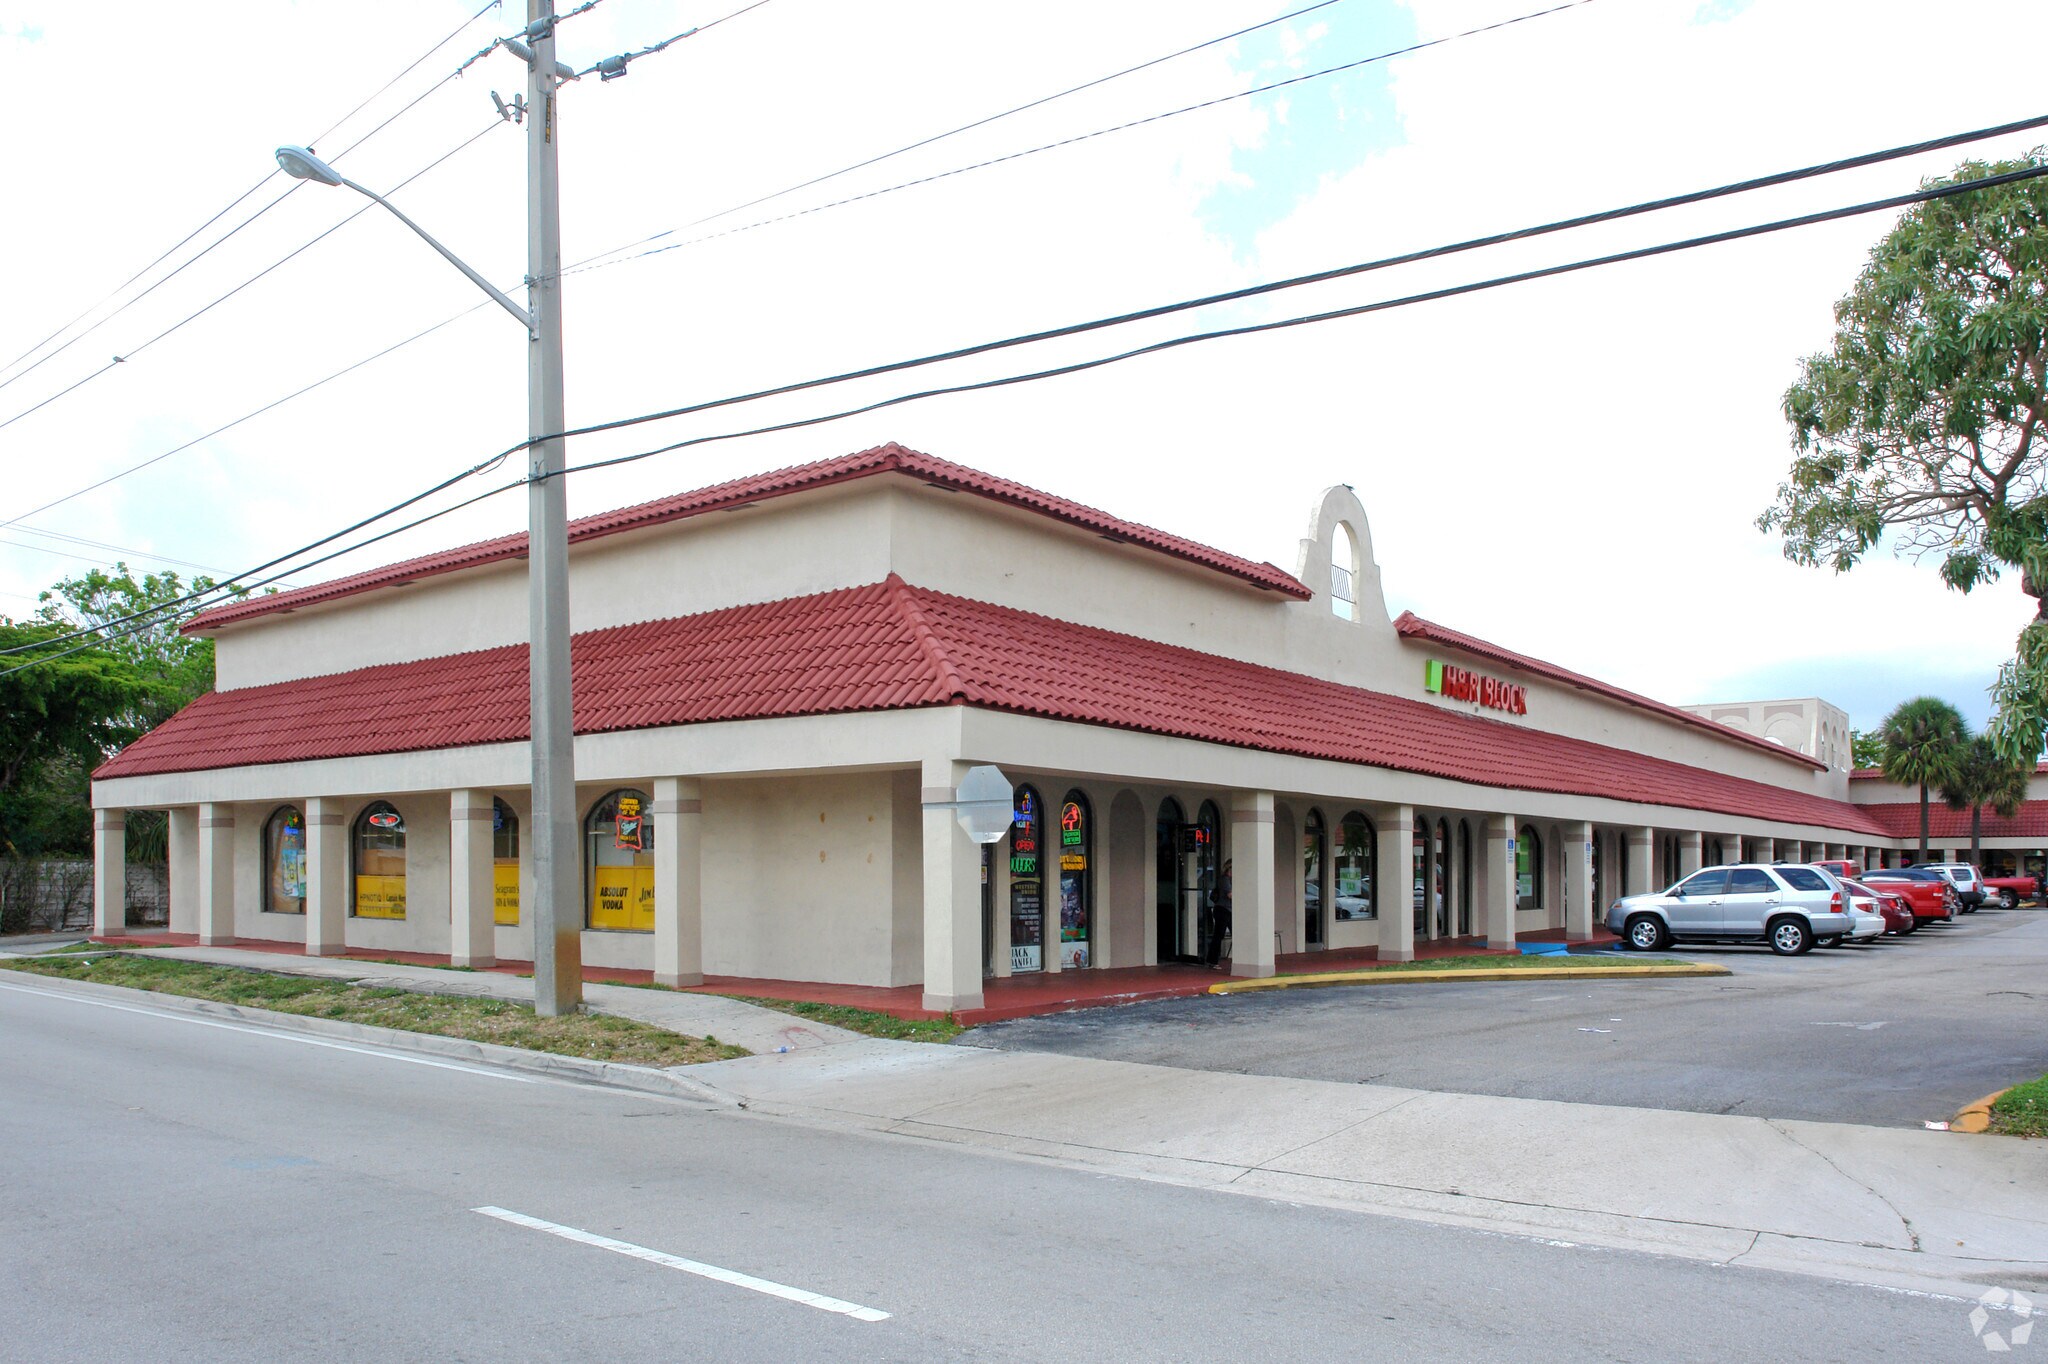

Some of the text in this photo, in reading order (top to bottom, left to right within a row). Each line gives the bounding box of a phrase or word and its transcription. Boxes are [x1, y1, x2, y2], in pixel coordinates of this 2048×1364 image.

[1442, 665, 1528, 715] H&R BLOCK
[1015, 840, 1035, 851] OPEN
[600, 887, 628, 897] ABSOLUT
[602, 900, 623, 910] VODKA
